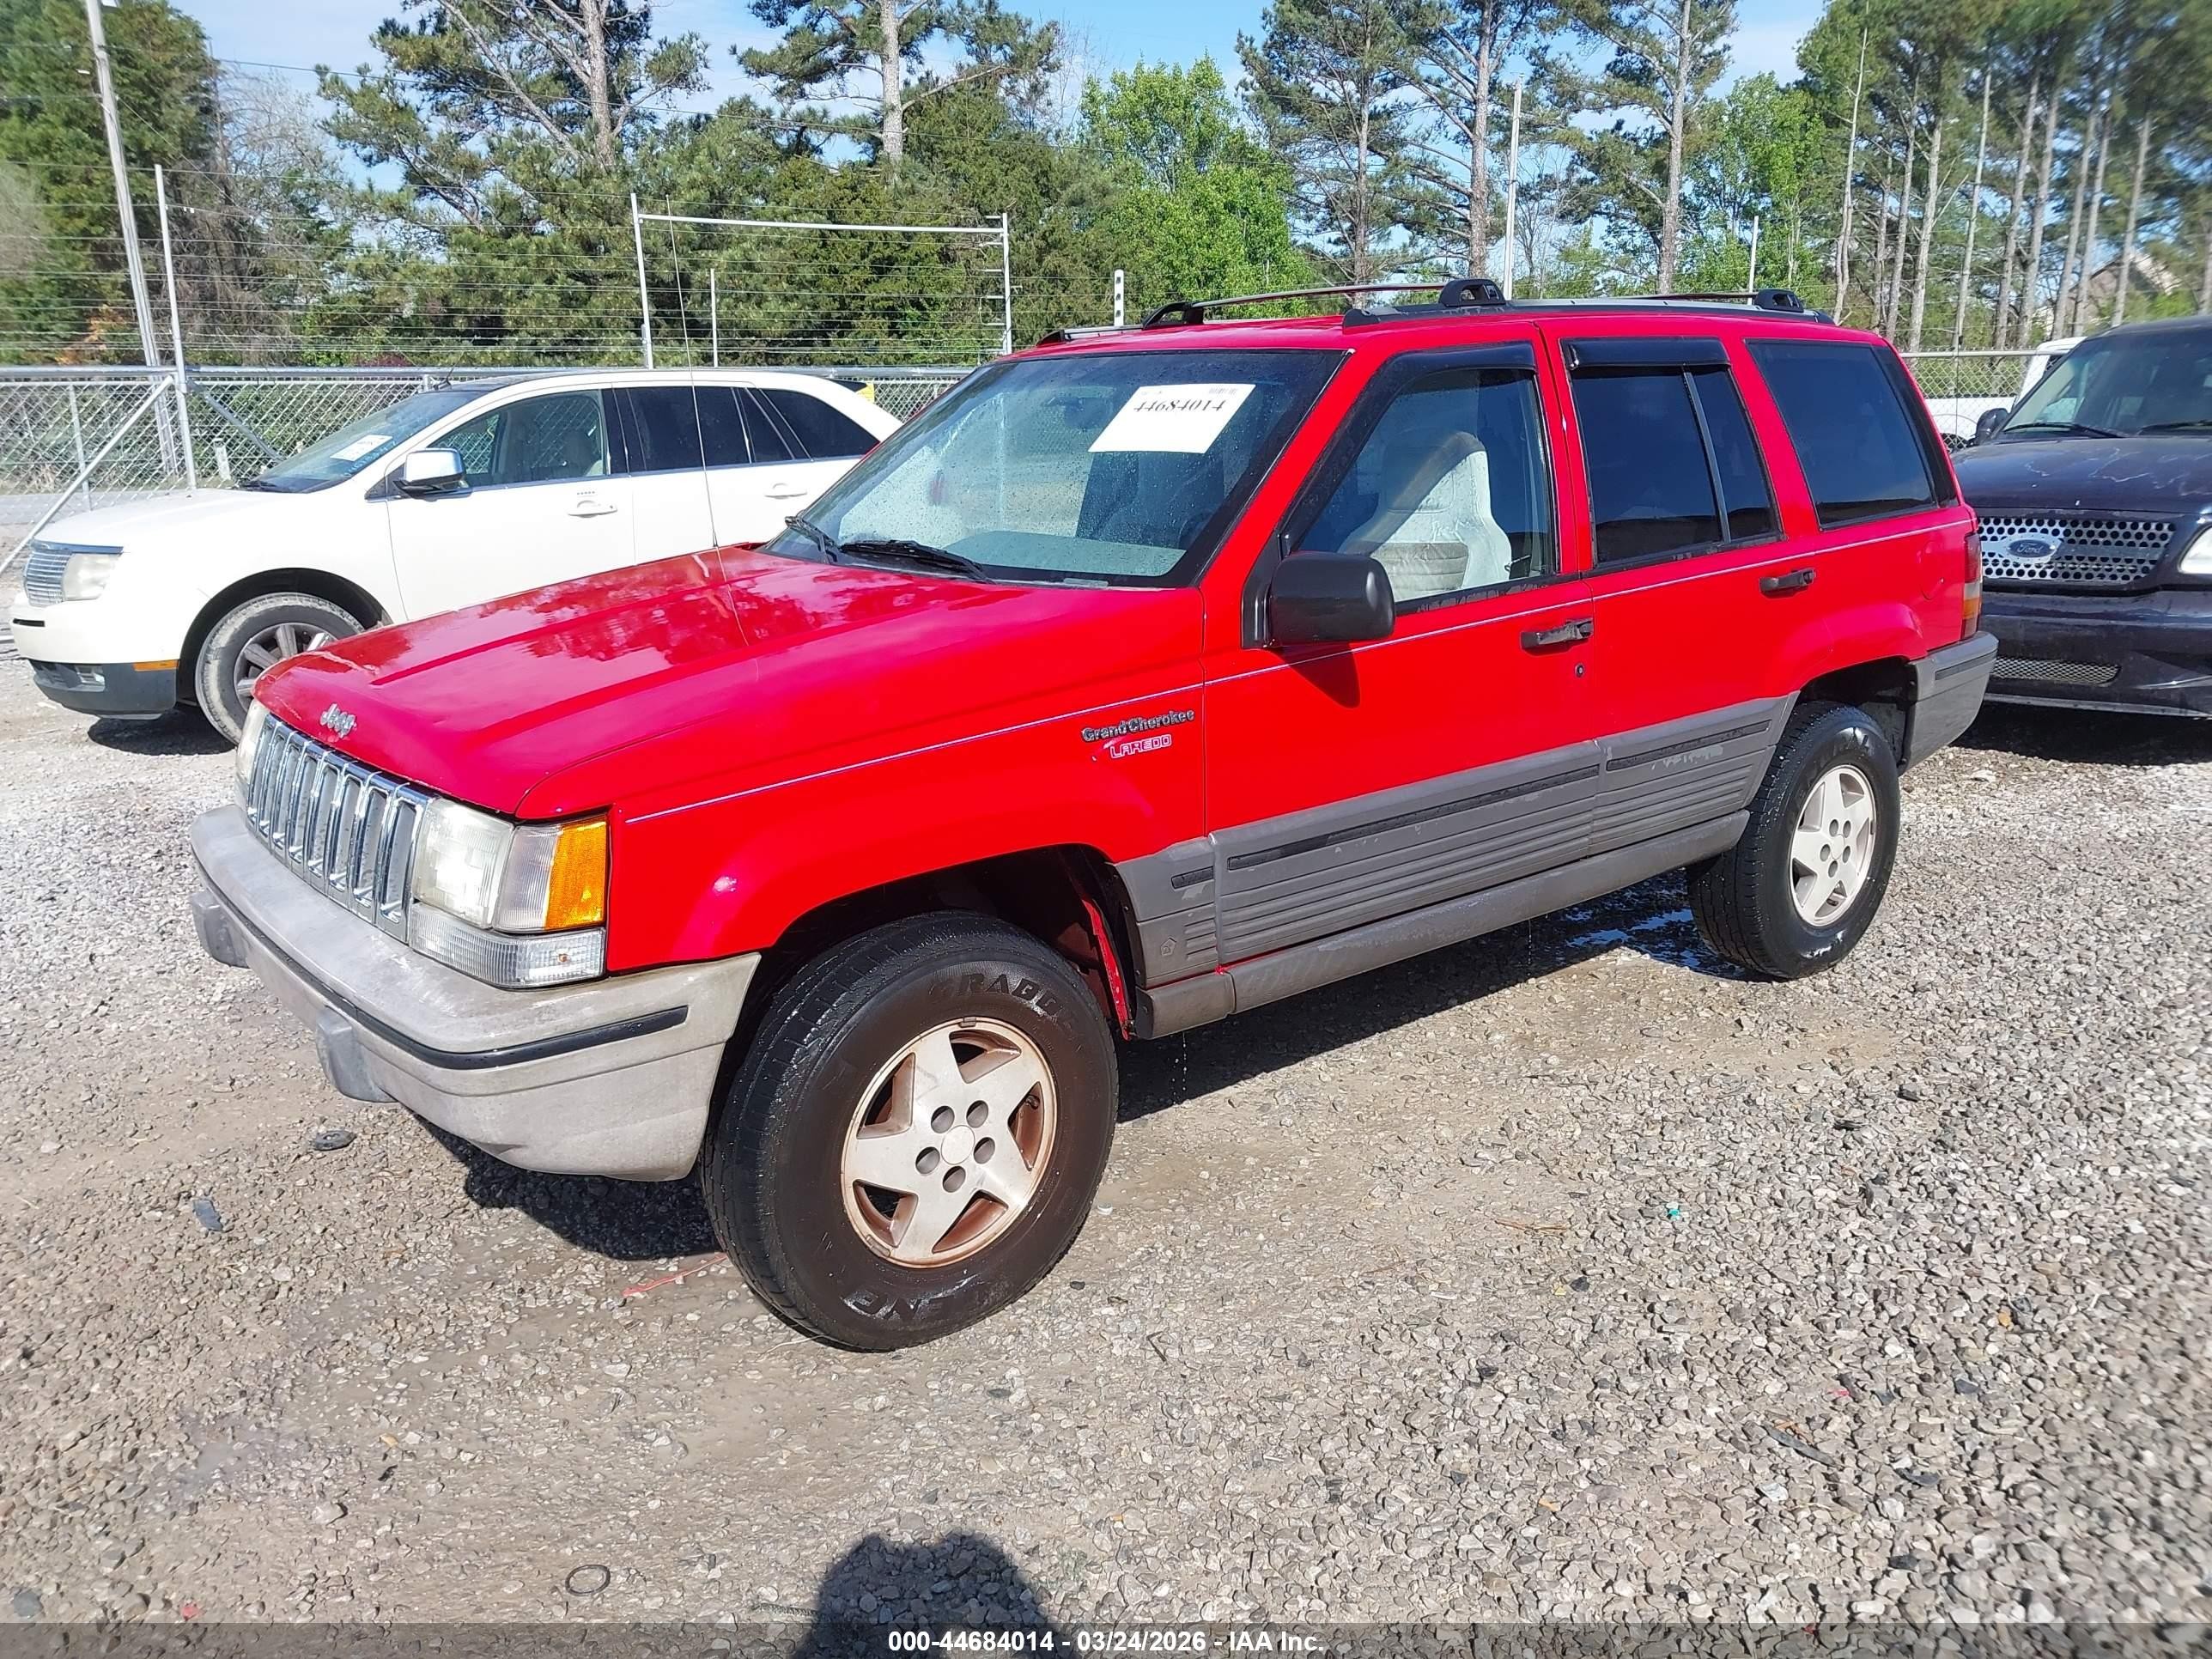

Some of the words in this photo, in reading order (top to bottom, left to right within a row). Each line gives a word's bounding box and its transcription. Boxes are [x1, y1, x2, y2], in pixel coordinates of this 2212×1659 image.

[1133, 399, 1227, 413] 44684014
[2016, 542, 2044, 554] Ford
[319, 702, 357, 738] Jeep
[1082, 720, 1127, 742] Grand
[1127, 709, 1195, 732] Cherokee
[1109, 733, 1173, 759] LAREDO
